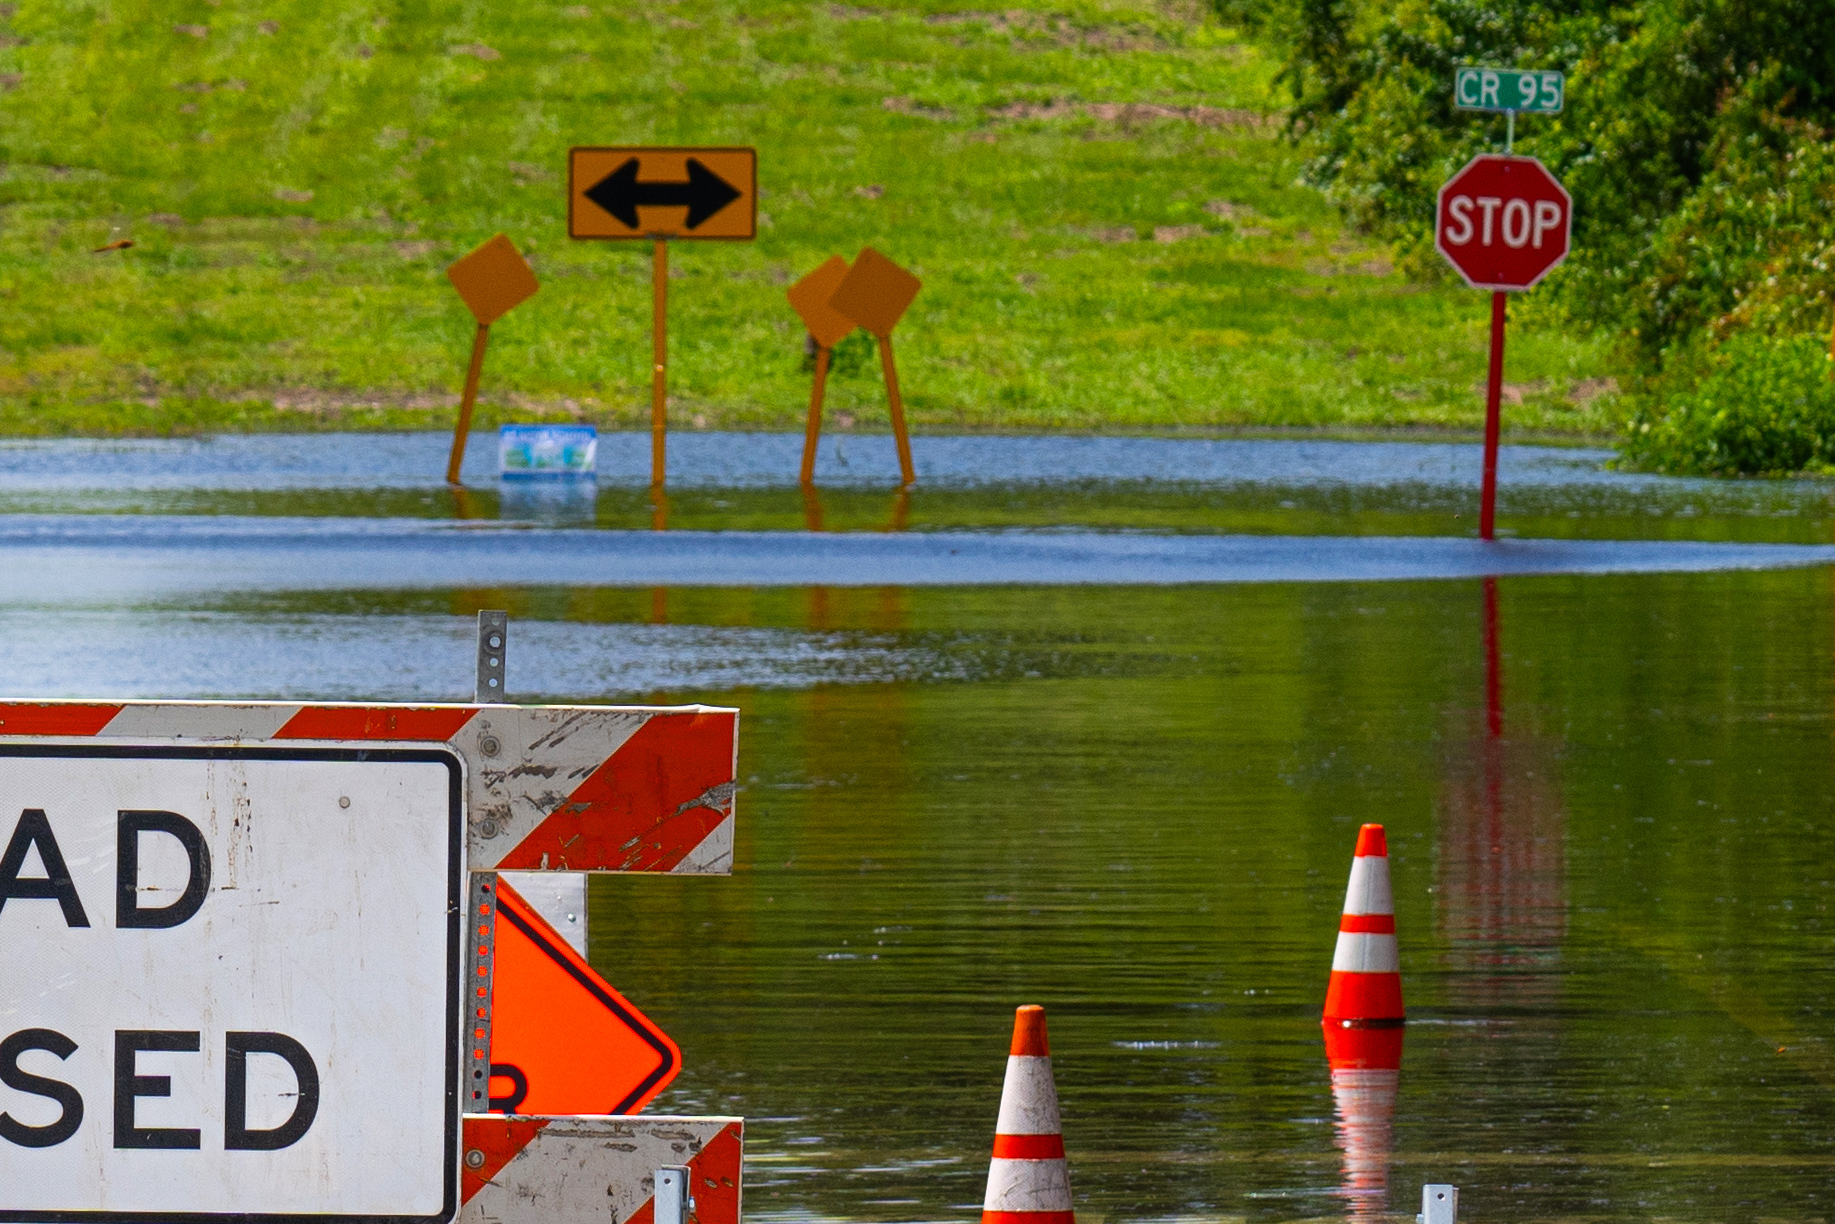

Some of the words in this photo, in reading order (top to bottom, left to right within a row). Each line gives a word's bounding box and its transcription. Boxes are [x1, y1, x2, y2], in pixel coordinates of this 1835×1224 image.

[1459, 73, 1501, 105] CR
[1518, 74, 1561, 107] 95
[1445, 194, 1562, 250] STOP
